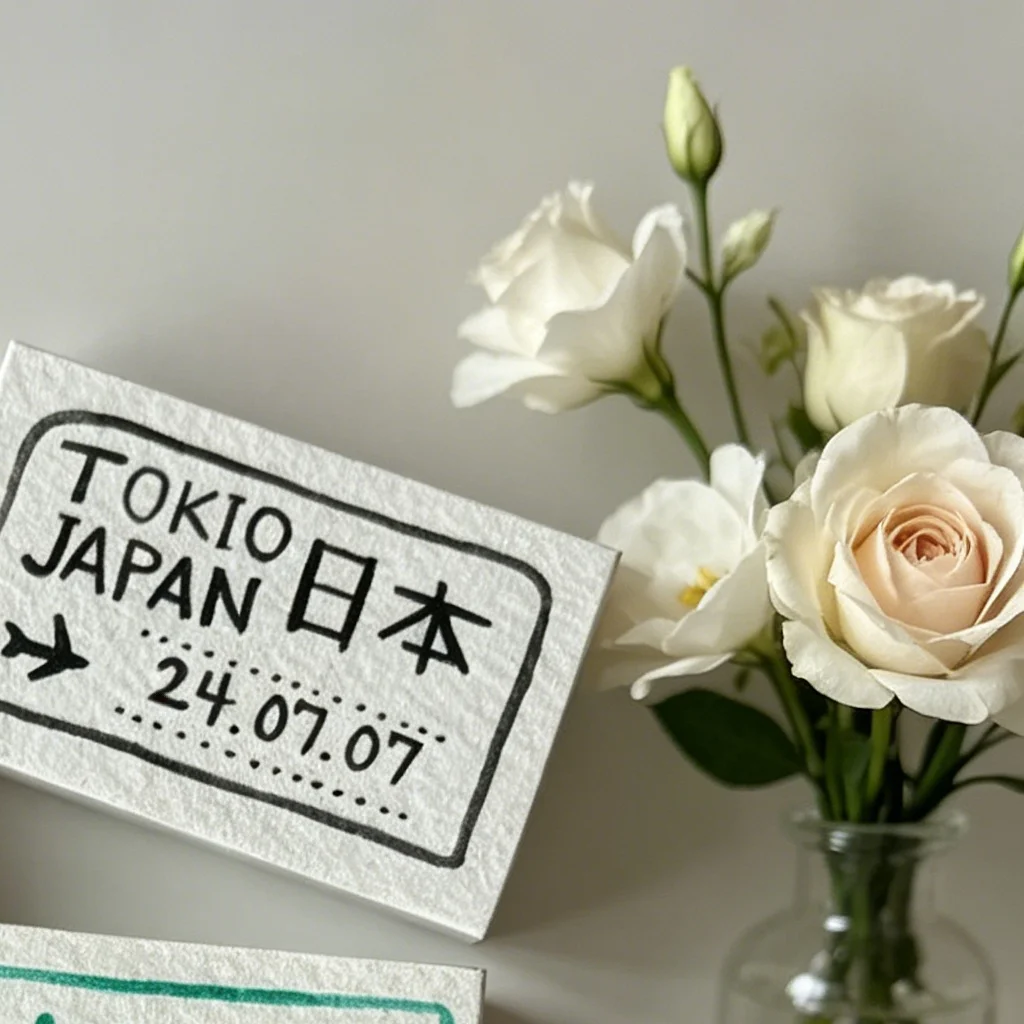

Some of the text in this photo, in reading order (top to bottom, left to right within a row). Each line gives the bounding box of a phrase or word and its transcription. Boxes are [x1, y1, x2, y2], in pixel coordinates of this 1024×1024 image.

[61, 439, 292, 562] TOKIO
[21, 514, 262, 634] JAPAN
[286, 538, 492, 675] 日本
[147, 656, 424, 785] 24.07.07
